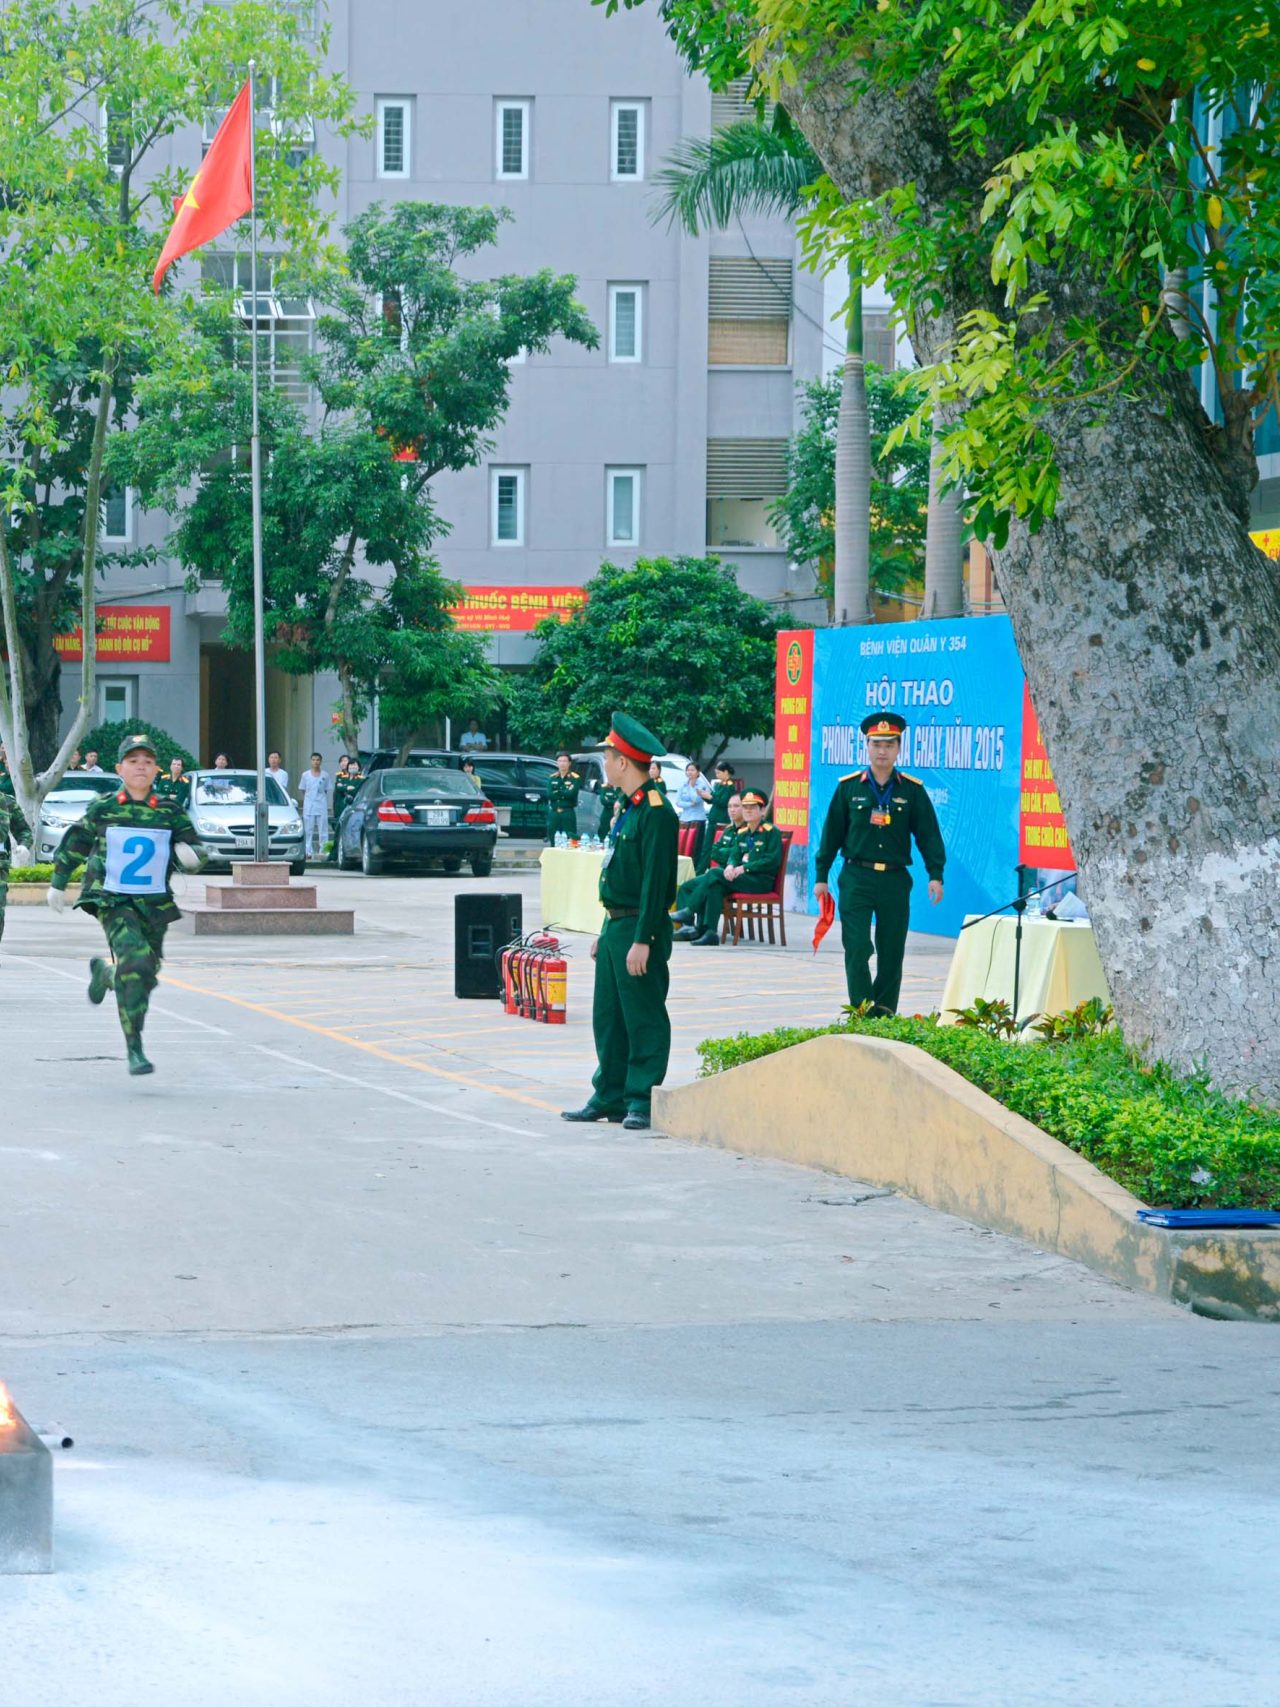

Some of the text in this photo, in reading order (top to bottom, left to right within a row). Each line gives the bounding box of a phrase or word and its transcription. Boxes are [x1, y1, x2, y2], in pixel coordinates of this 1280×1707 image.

[464, 590, 507, 609] THUỐC
[511, 592, 548, 612] BỆNH
[860, 633, 966, 659] BỆNH VIỆN QUÂN Y 354
[865, 674, 954, 712] HỘI THAO
[914, 718, 943, 768] CHÁY
[945, 716, 972, 770] NĂM
[974, 726, 1005, 771] 2015
[120, 836, 156, 885] 2
